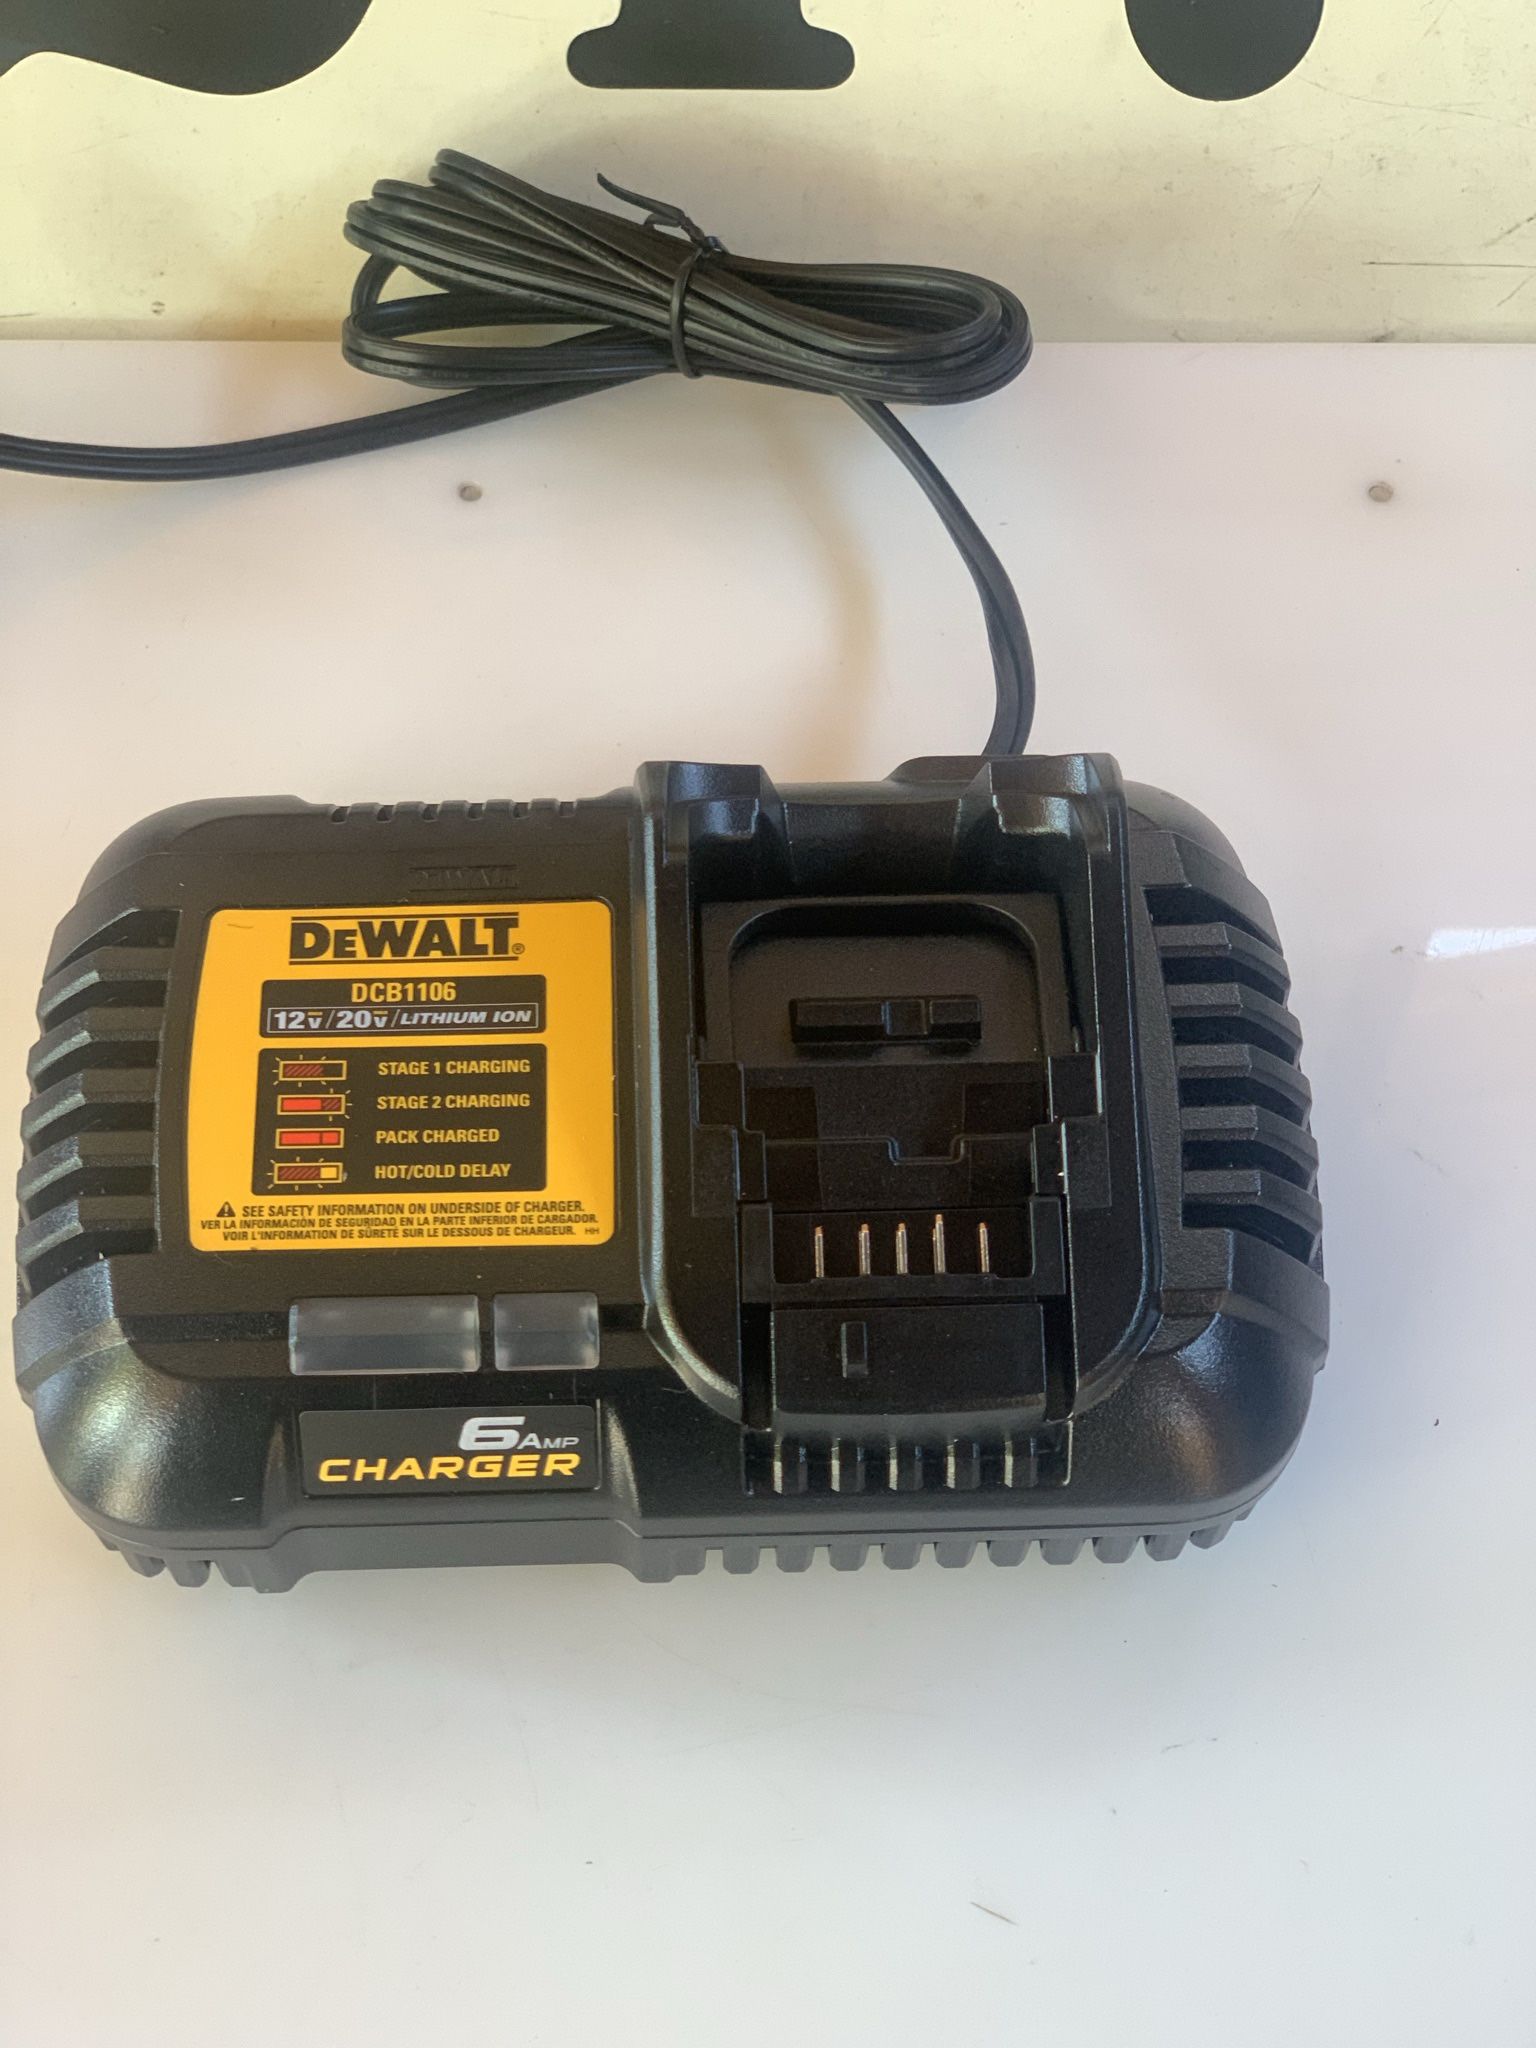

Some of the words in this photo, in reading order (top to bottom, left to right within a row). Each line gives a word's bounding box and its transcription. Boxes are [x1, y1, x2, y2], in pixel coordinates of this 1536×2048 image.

[351, 982, 456, 1003] DCB1106
[492, 1010, 532, 1023] ION
[378, 1062, 429, 1076] STAGE
[434, 1062, 440, 1074] 1
[446, 1060, 531, 1074] CHARGING
[377, 1096, 428, 1110] STAGE
[432, 1096, 441, 1109] 2
[445, 1094, 531, 1109] CHARGING
[376, 1130, 418, 1144] PACK
[423, 1129, 500, 1143] CHARGED
[374, 1165, 455, 1180] HOT/COLD
[460, 1164, 511, 1177] DELAY
[242, 1206, 264, 1217] SEE
[268, 1205, 314, 1217] SAFETY
[318, 1203, 404, 1216] INFORMATION
[408, 1203, 427, 1214] ON
[431, 1201, 501, 1214] UNDERSIDE
[505, 1201, 520, 1213] OF
[524, 1201, 585, 1212] CHARGER.
[200, 1220, 221, 1230] VER
[224, 1220, 236, 1229] LA
[319, 1218, 332, 1228] DE
[336, 1217, 396, 1228] SEGURIDAD
[401, 1217, 413, 1226] EN
[417, 1216, 429, 1226] LA
[433, 1216, 466, 1226] PARTE
[469, 1215, 517, 1225] INFERIOR
[521, 1214, 534, 1224] DE
[223, 1231, 248, 1241] VOIR
[342, 1229, 354, 1239] DE
[402, 1227, 424, 1237] SUR
[427, 1227, 439, 1237] LE
[442, 1226, 494, 1237] DESSOUS
[497, 1226, 510, 1236] DE
[318, 1453, 581, 1482] CHARGER
